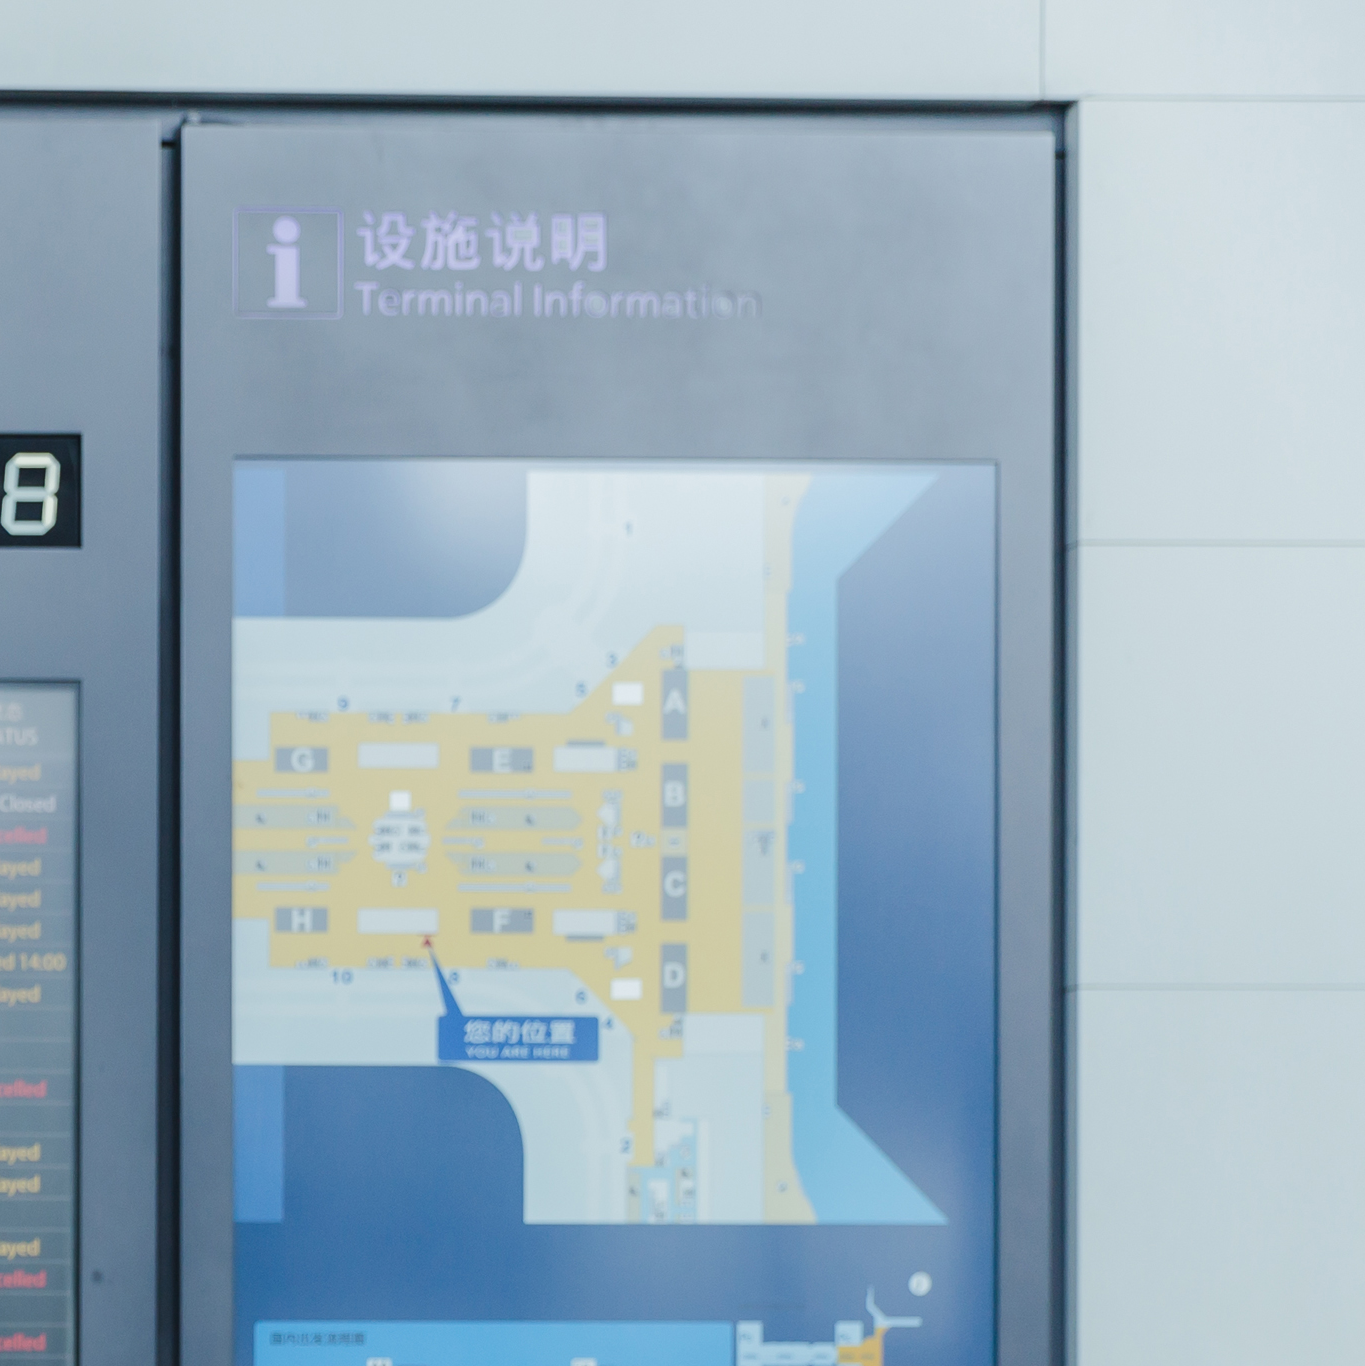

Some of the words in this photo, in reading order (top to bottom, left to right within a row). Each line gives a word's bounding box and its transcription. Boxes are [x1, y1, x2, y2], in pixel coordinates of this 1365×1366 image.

[355, 210, 608, 271] 设施说明
[354, 280, 521, 318] Terminal
[534, 281, 763, 320] Information
[663, 688, 686, 714] A
[291, 749, 314, 771] G
[493, 750, 511, 772] E
[665, 781, 685, 806] B
[664, 872, 686, 897] C
[291, 910, 312, 932] H
[494, 911, 511, 932] F
[20, 953, 66, 971] 14:00
[664, 963, 685, 988] D
[463, 1019, 575, 1044] 您的位置
[466, 1045, 499, 1059] YOU
[500, 1045, 528, 1059] ARE
[533, 1045, 569, 1059] HERE
